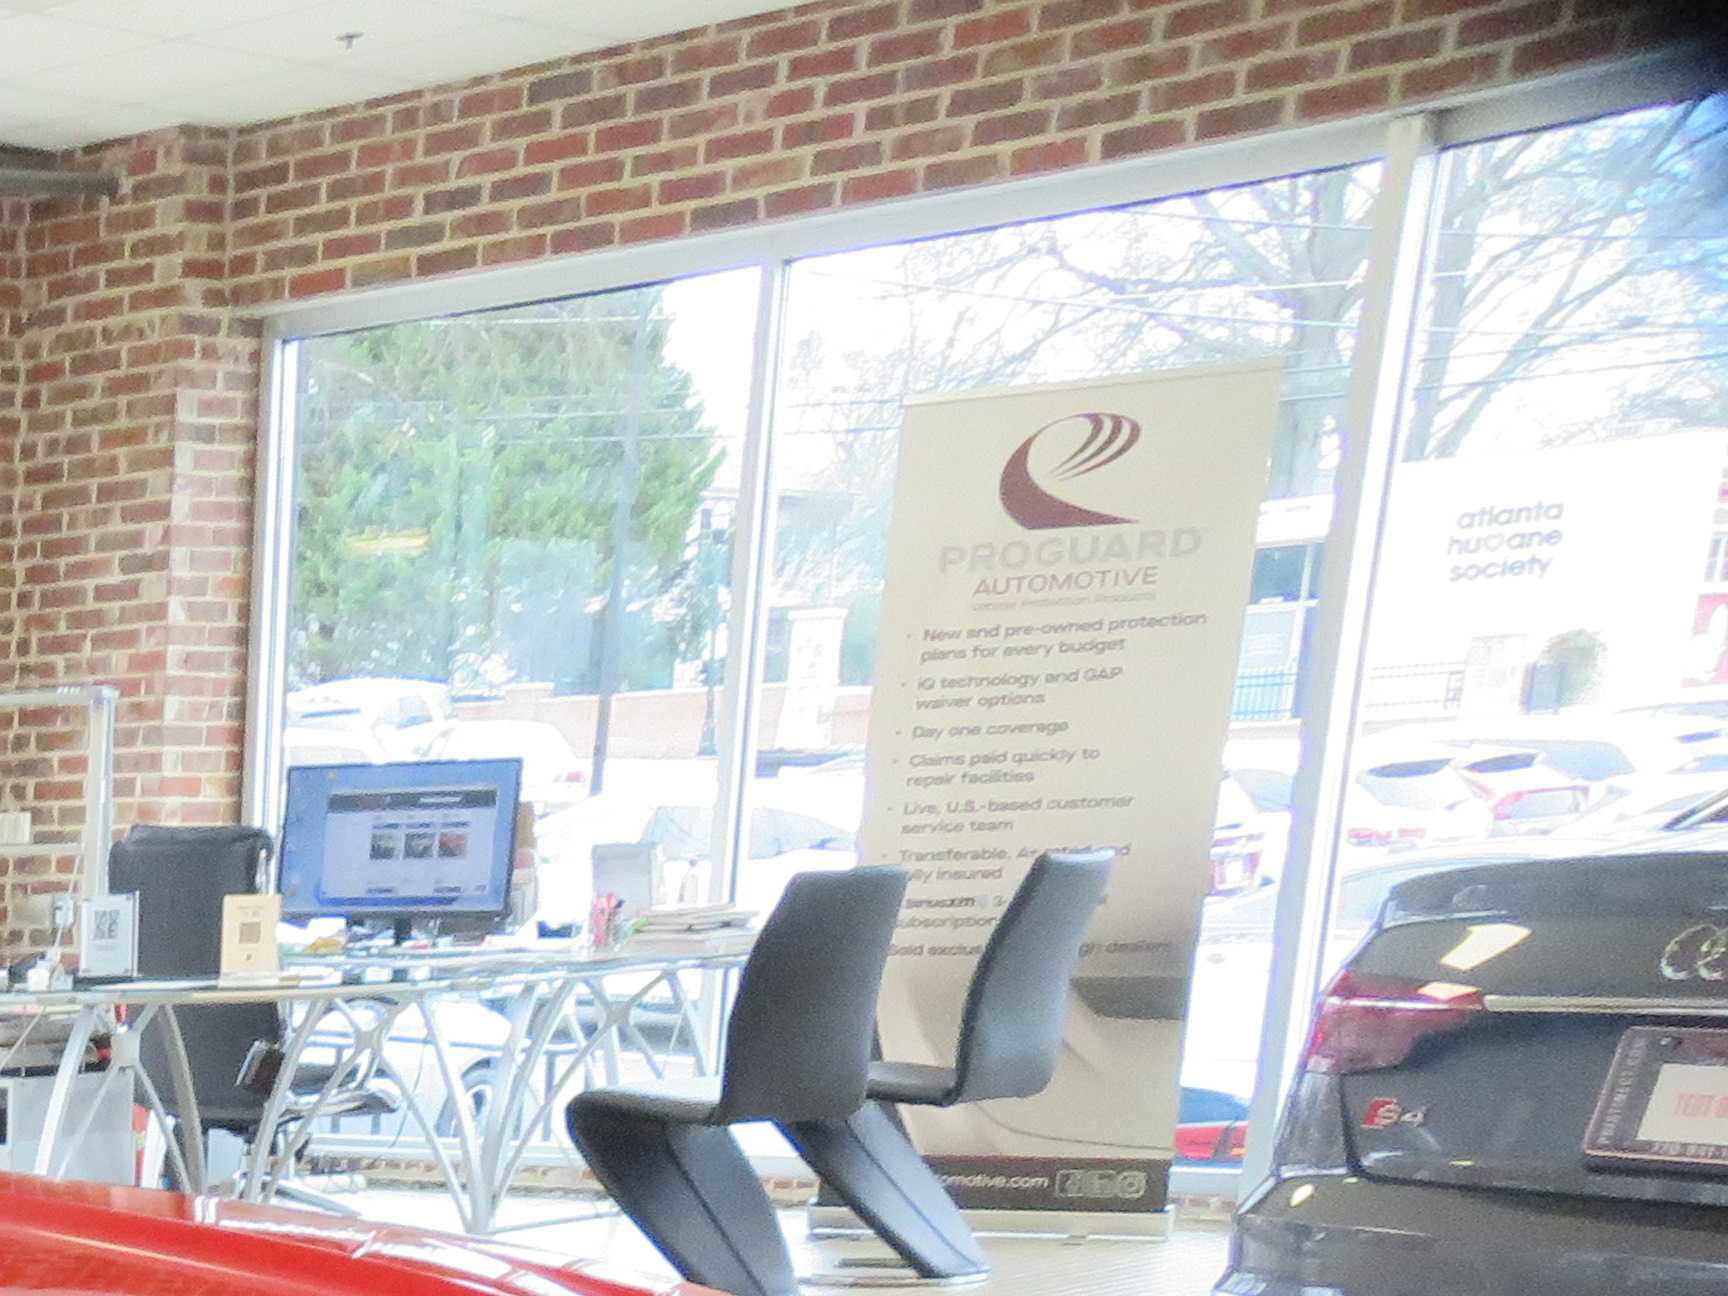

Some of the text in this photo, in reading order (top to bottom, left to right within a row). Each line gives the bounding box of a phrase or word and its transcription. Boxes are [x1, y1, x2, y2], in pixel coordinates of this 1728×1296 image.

[1457, 500, 1563, 529] atlanta
[939, 527, 1202, 573] PROGUARD
[1448, 554, 1553, 582] society
[973, 566, 1159, 597] AUTOMOTIVE
[923, 612, 1207, 642] New and pre-owned protection
[919, 637, 1127, 665] plans for every budget
[940, 671, 1041, 690] technology
[1044, 667, 1080, 683] and
[1083, 666, 1124, 682] GAP
[915, 692, 1047, 711] waiver options
[911, 719, 1070, 740] Day one coverage
[908, 747, 1101, 768] Claims paid quickly to
[905, 769, 1035, 788] repair facilities
[1046, 795, 1135, 811] customer
[901, 818, 1014, 835] service team
[1363, 1098, 1427, 1129] S4
